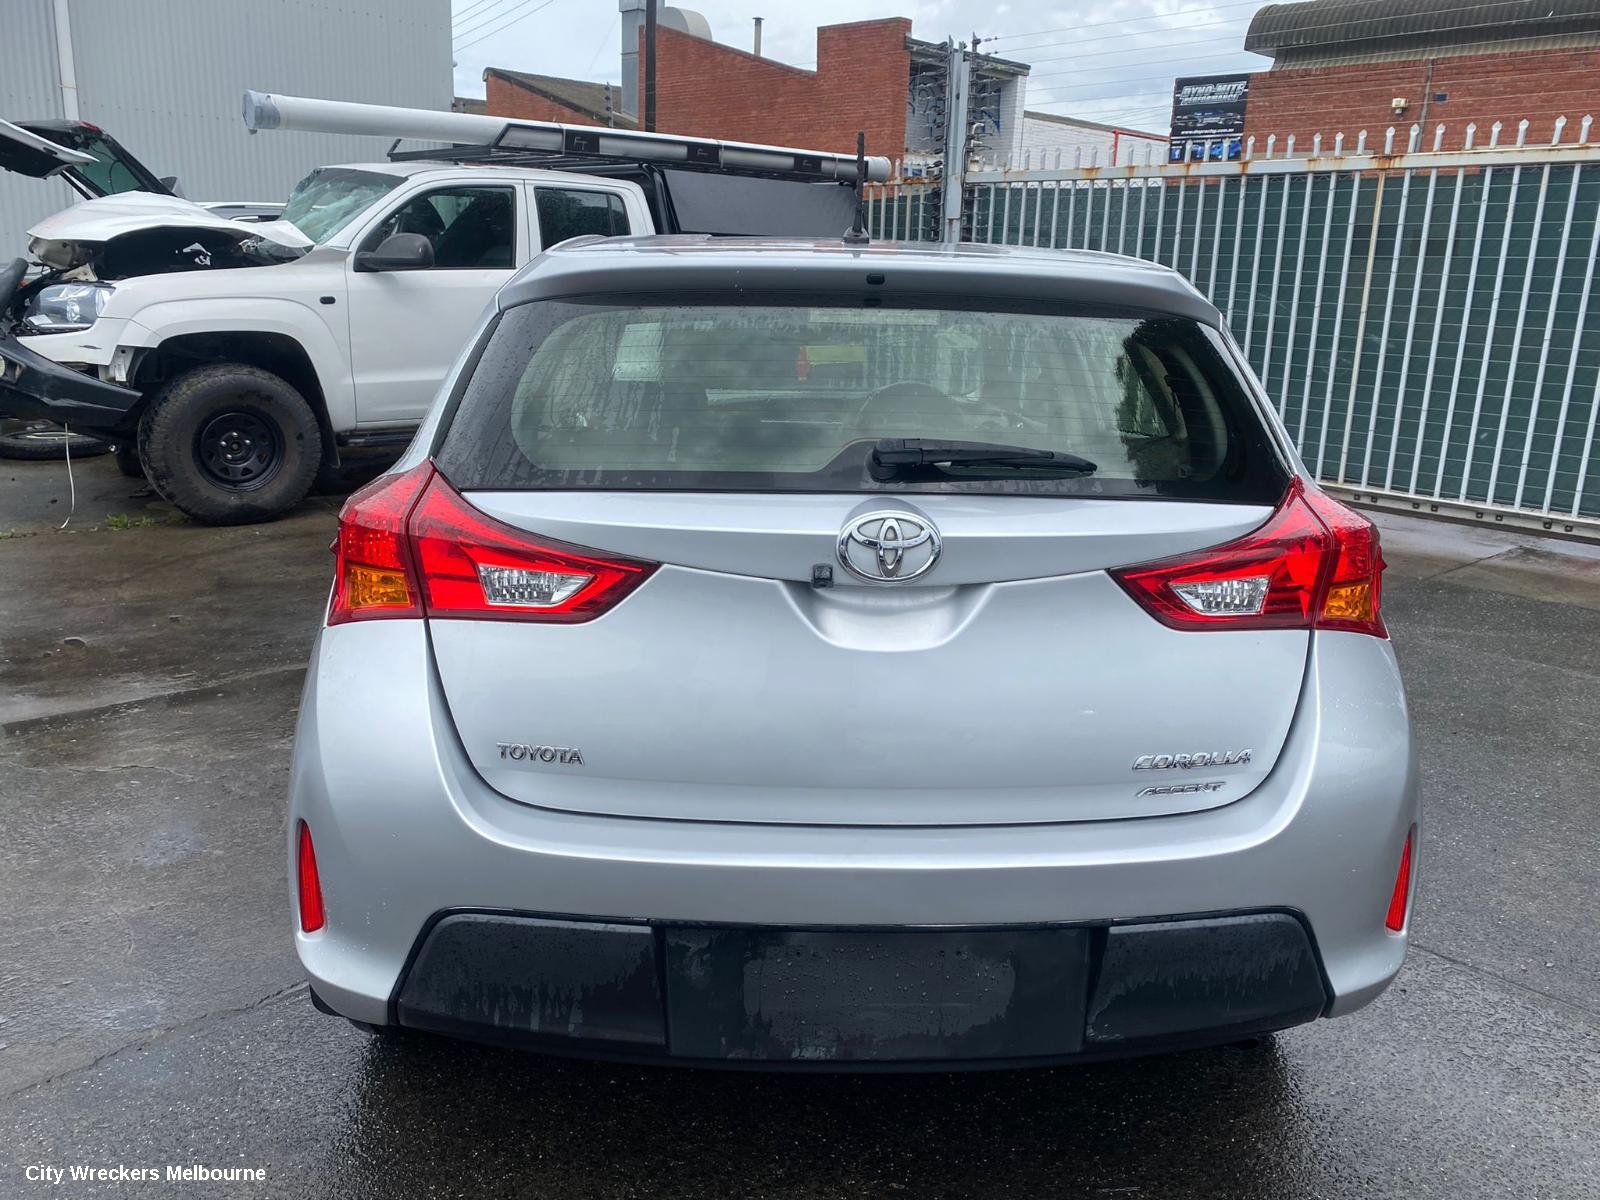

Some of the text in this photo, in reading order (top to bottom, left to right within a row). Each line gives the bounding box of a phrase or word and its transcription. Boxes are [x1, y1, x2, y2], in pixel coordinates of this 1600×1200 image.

[1182, 83, 1245, 97] DYNO-MITE
[496, 742, 585, 765] TOYOTA
[1132, 748, 1253, 770] COROLLA
[1136, 781, 1226, 797] ASCENT
